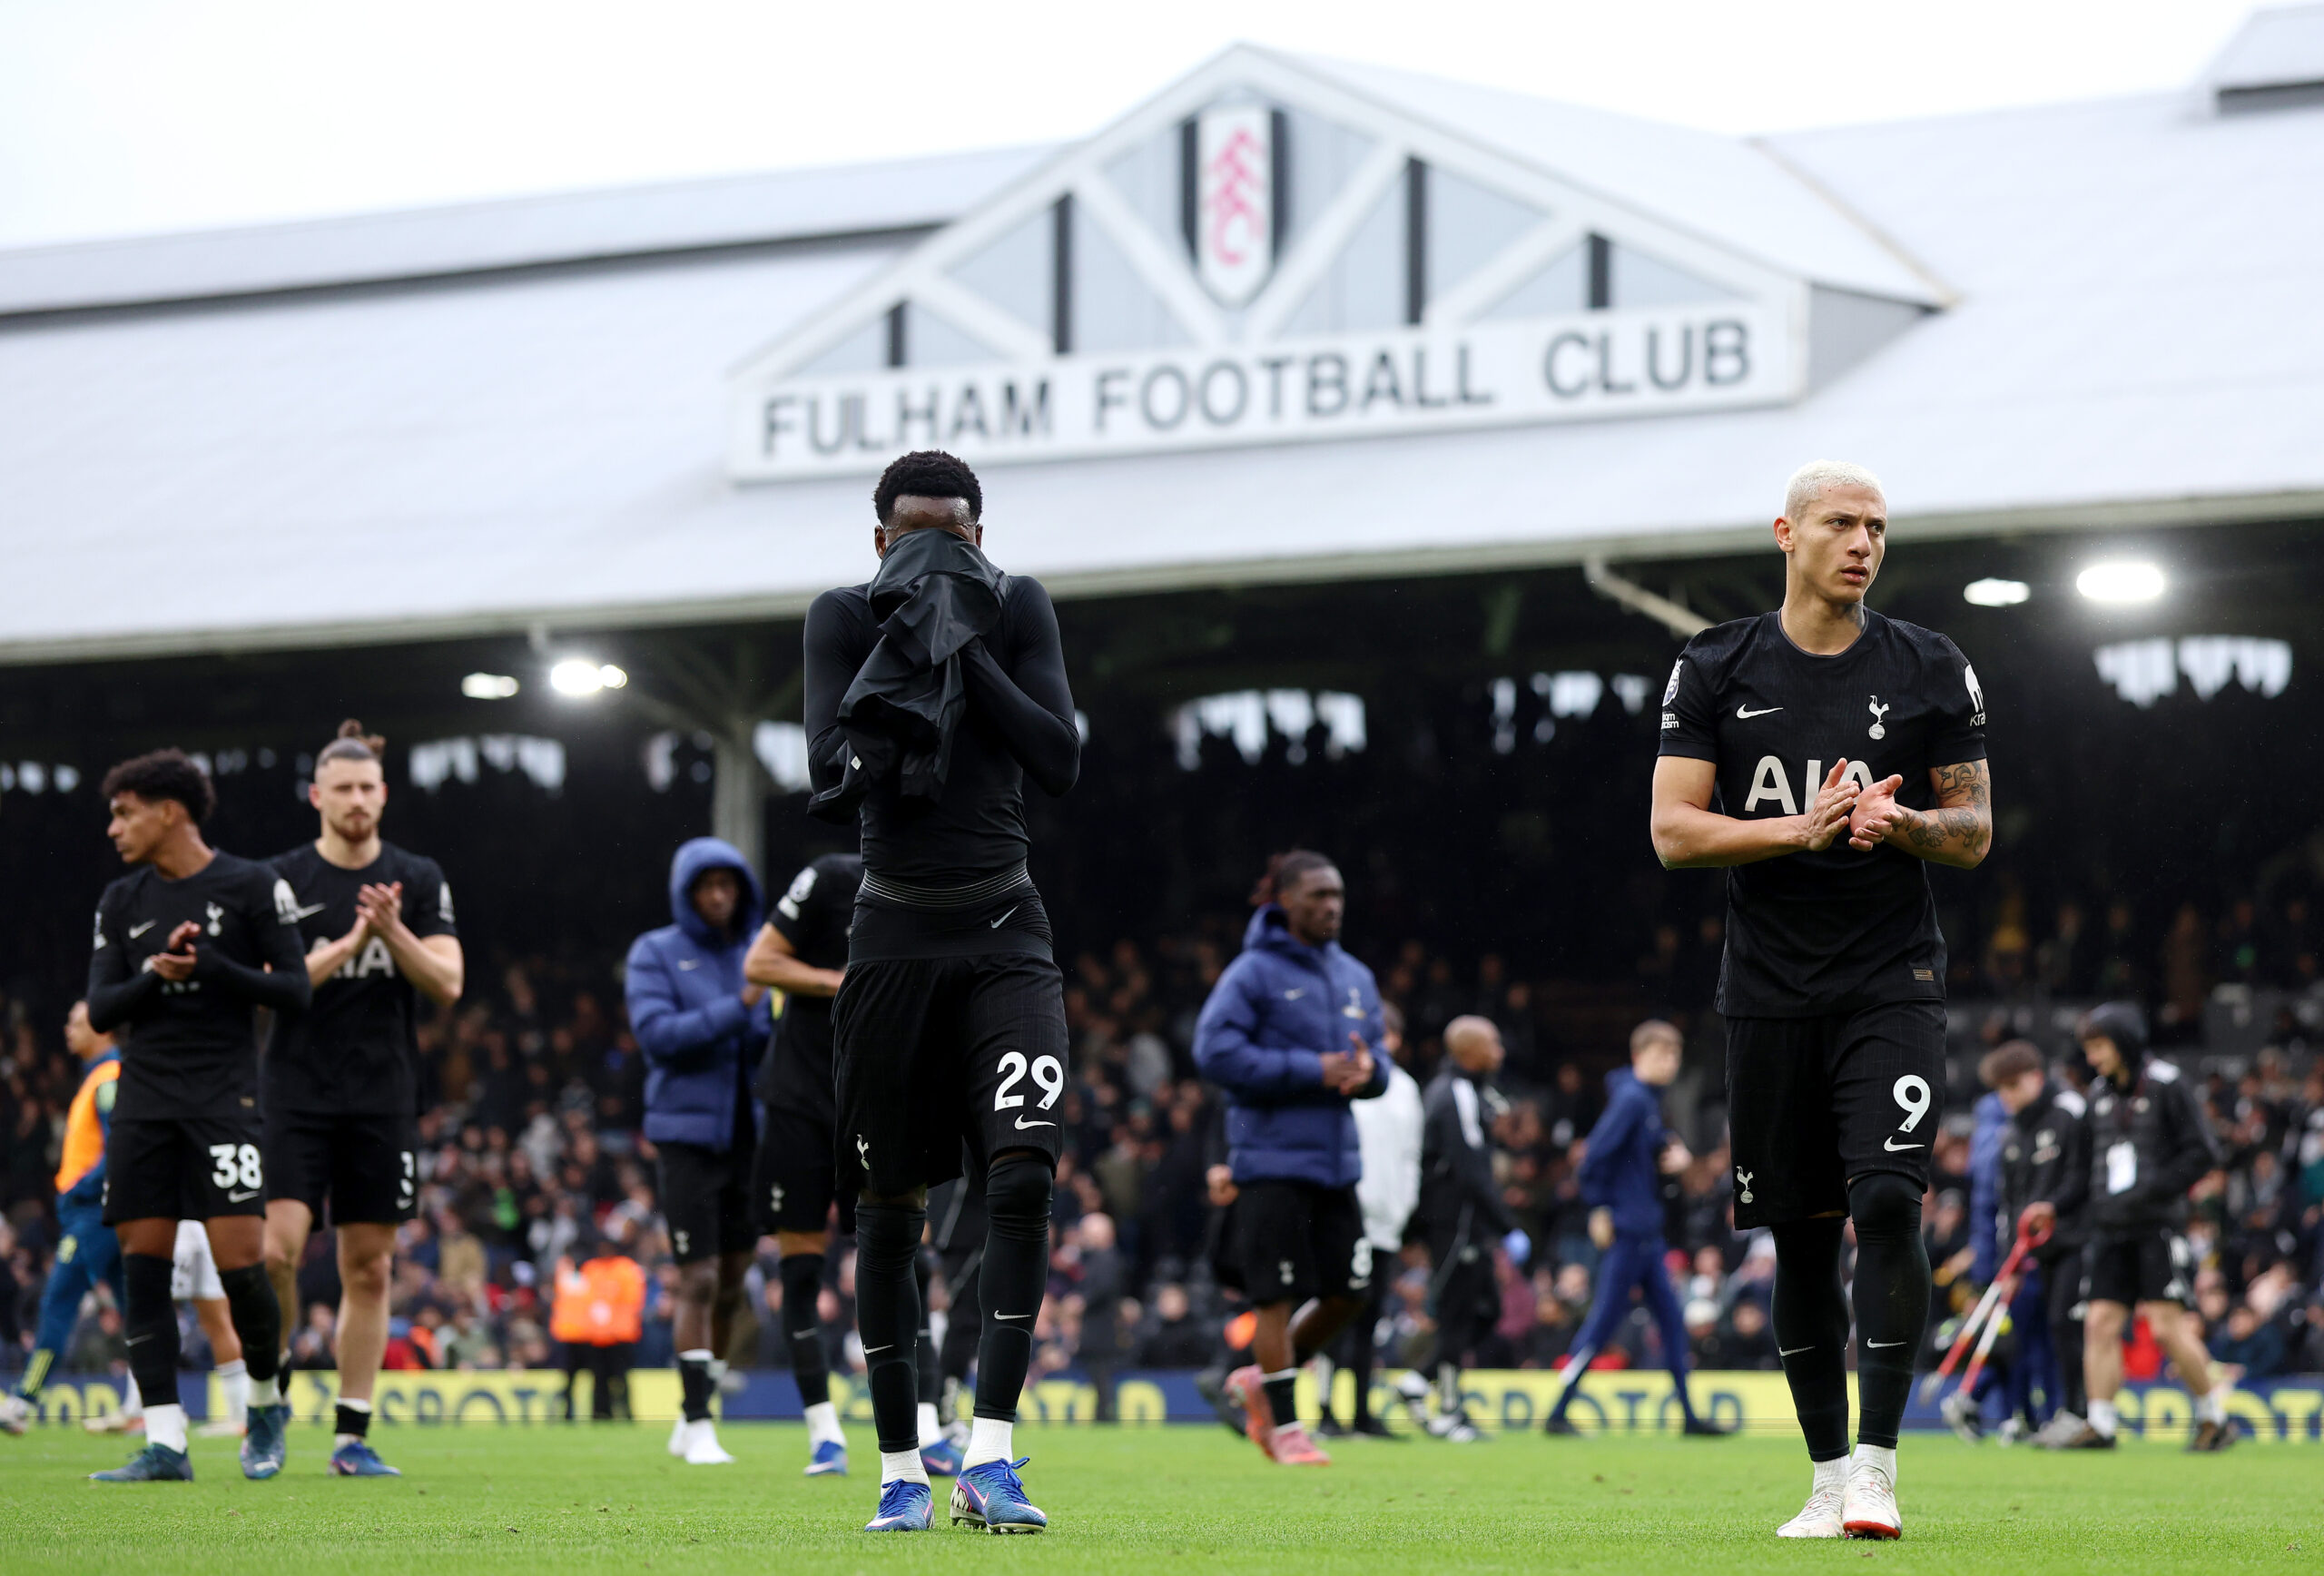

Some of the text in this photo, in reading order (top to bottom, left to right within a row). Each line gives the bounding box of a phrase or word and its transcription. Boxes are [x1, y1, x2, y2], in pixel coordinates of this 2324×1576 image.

[761, 320, 1750, 458] FULHAM FOOTBALL CLUB
[993, 1050, 1065, 1112] 29
[1893, 1074, 1932, 1134] 9
[208, 1142, 263, 1190] 38
